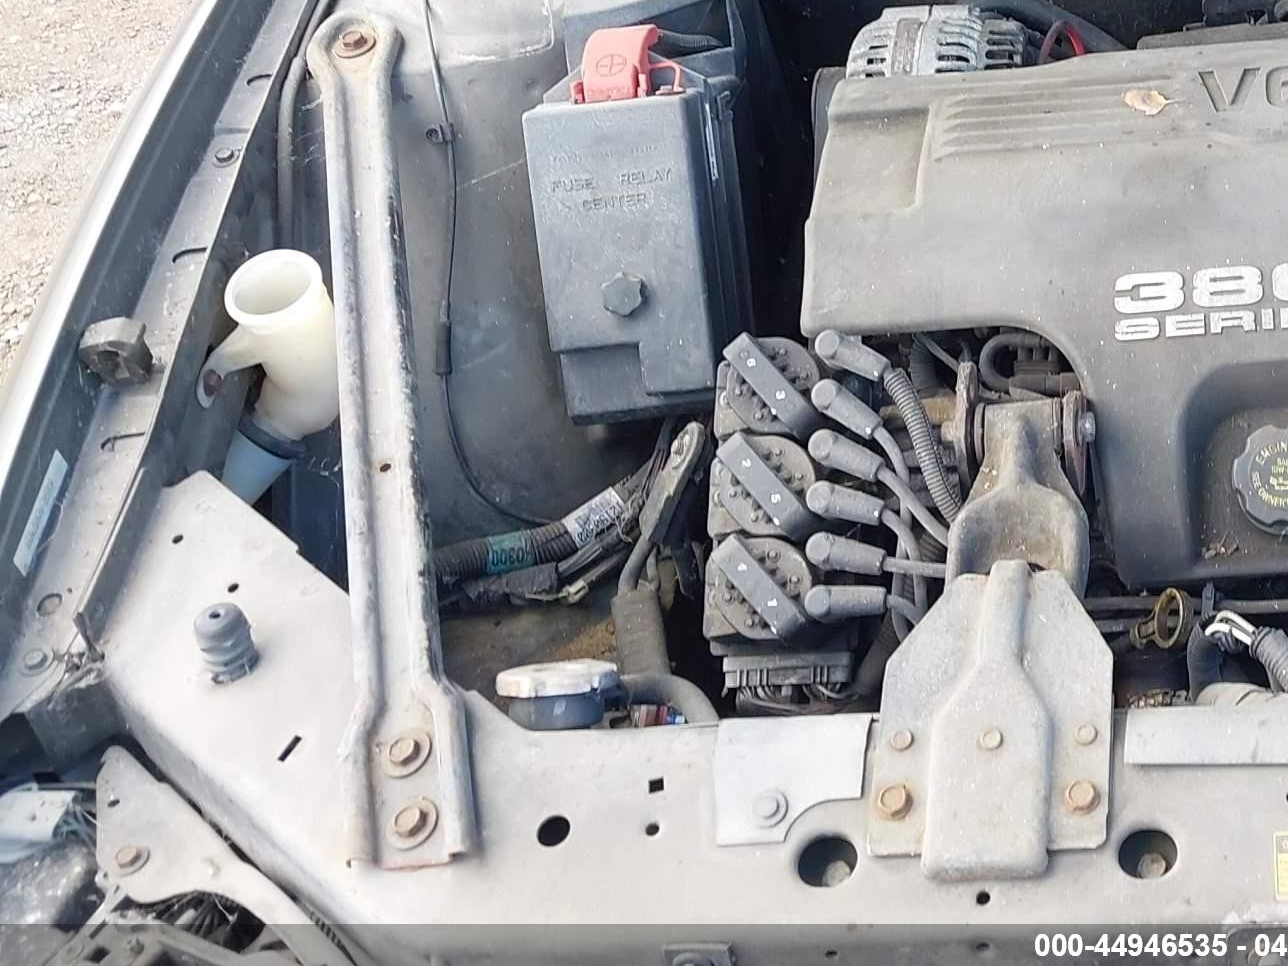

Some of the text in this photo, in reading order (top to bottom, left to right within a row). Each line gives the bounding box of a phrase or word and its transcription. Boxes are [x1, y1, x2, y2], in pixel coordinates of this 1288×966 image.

[550, 167, 672, 193] FUSE RELAY
[582, 192, 647, 212] CENTER
